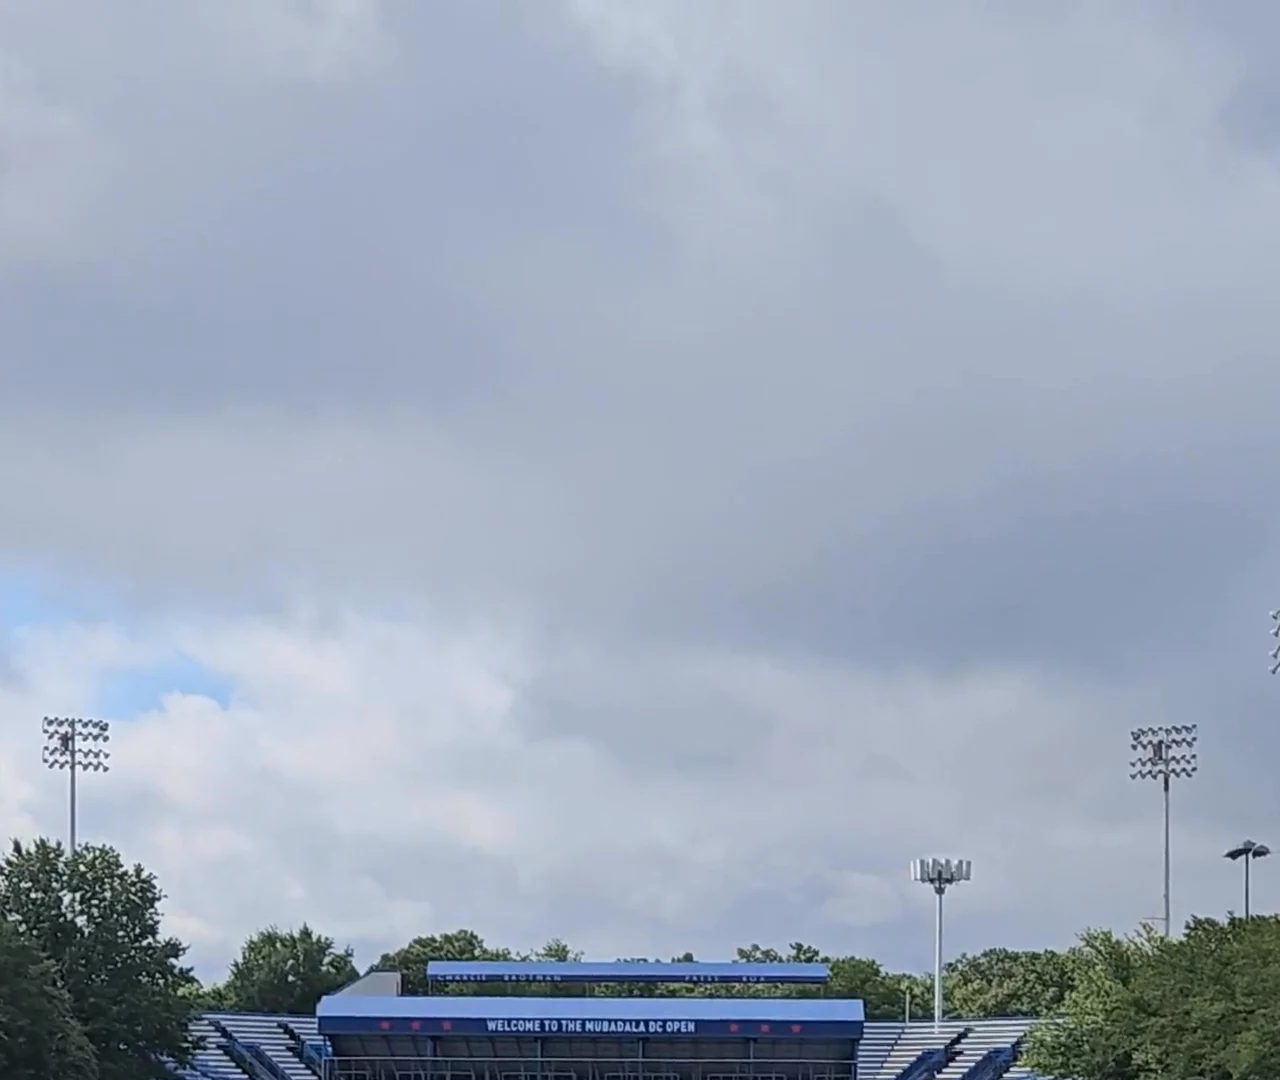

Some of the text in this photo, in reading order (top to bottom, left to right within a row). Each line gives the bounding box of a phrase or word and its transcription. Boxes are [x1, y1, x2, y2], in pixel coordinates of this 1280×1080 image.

[486, 1019, 695, 1033] WELCOME TO THE MUBADALA DC OPEN
